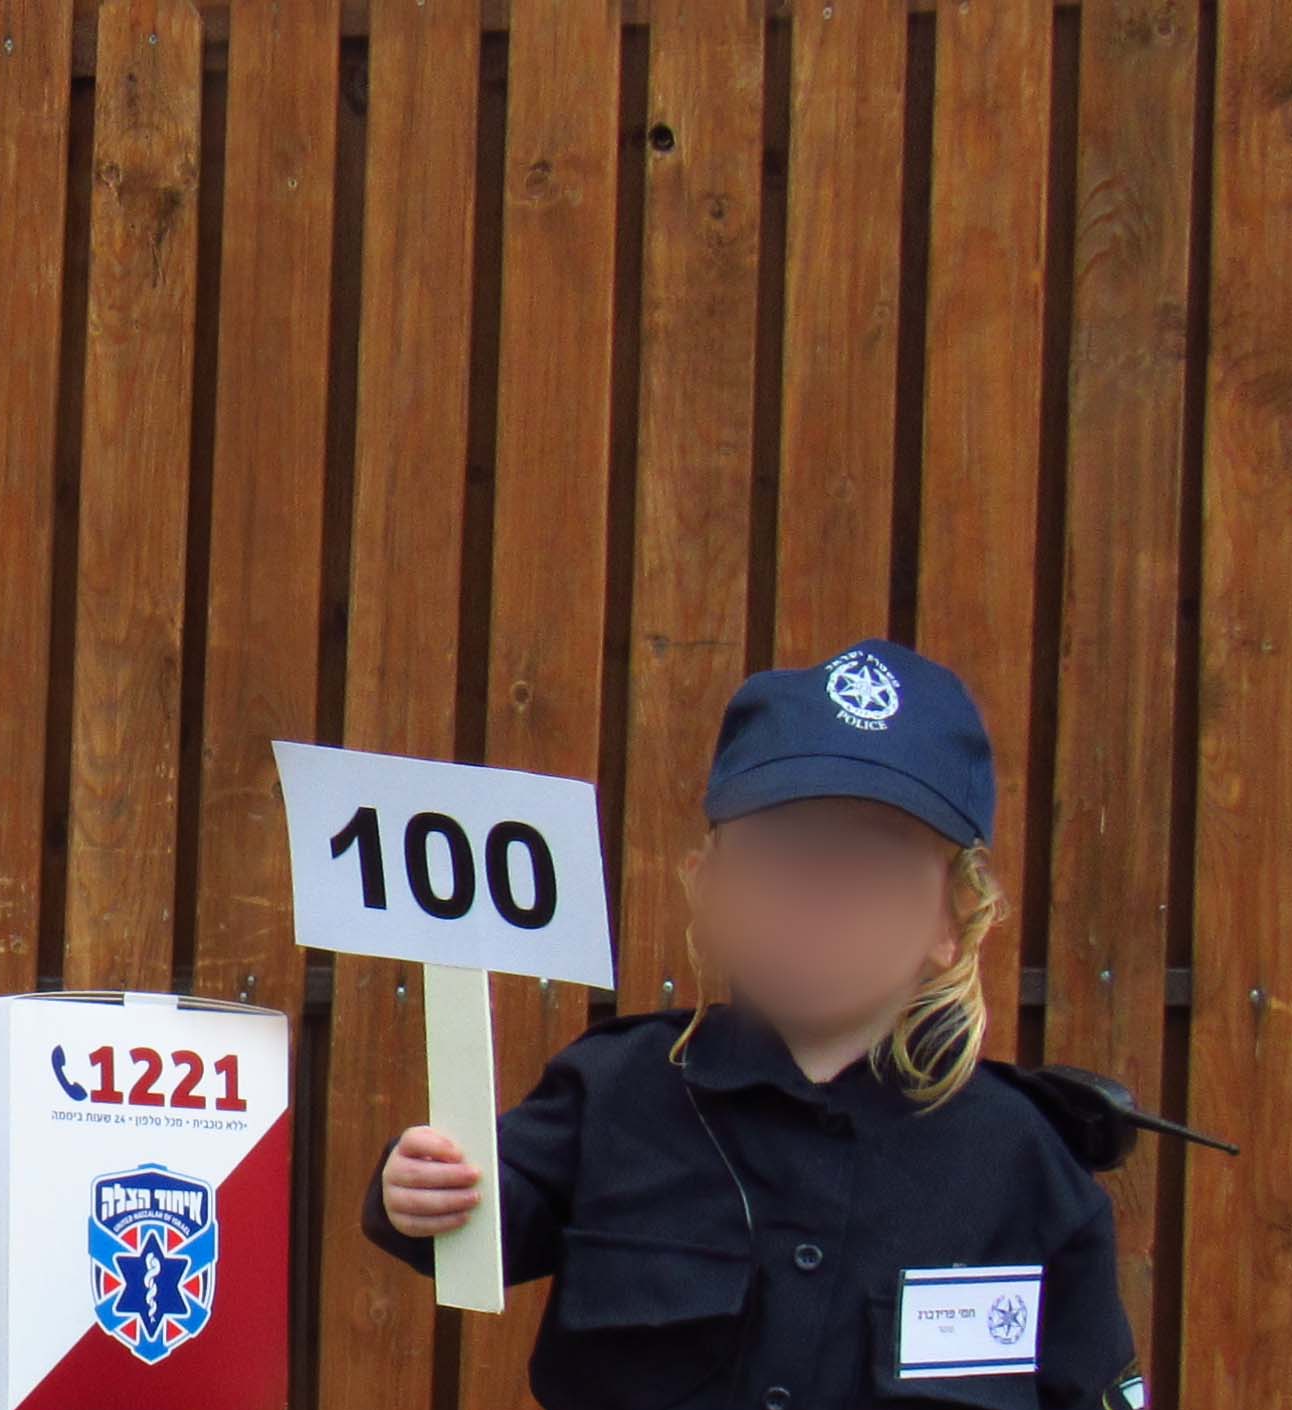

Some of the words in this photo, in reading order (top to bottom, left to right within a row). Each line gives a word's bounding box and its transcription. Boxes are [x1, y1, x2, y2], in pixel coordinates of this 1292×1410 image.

[836, 709, 889, 731] POLICE
[329, 806, 557, 930] 100
[88, 1045, 248, 1112] 1221
[114, 1114, 126, 1124] 24
[101, 1183, 151, 1222] הצלה
[153, 1188, 204, 1227] איחוד
